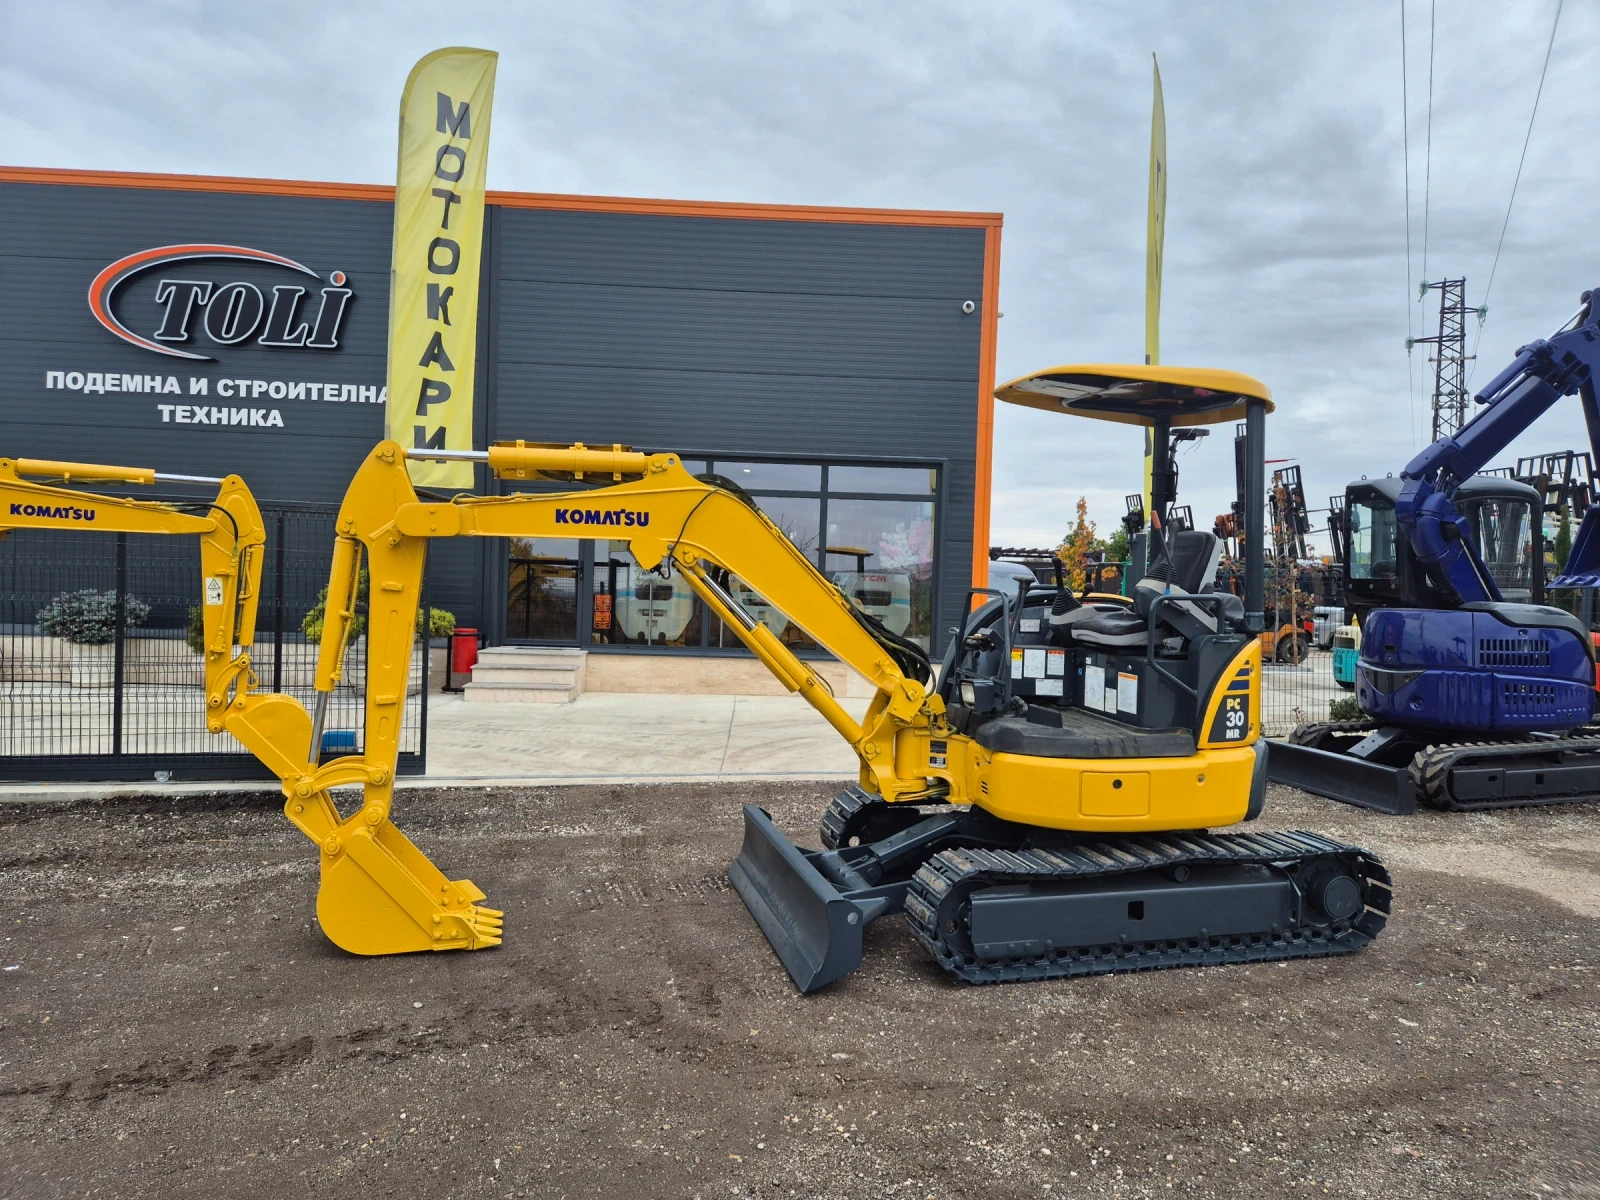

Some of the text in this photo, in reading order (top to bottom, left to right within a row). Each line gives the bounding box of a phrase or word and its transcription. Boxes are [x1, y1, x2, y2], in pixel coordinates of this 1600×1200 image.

[413, 91, 471, 464] МОТОКАРИ
[46, 371, 182, 395] ПОДЕМНА
[189, 377, 209, 396] И
[157, 404, 285, 428] ТЕХНИКА
[9, 503, 96, 521] KOMATSU
[555, 508, 650, 527] KOMATSU
[1226, 698, 1241, 710] PC
[1225, 711, 1245, 727] 30
[1225, 728, 1240, 739] MR
